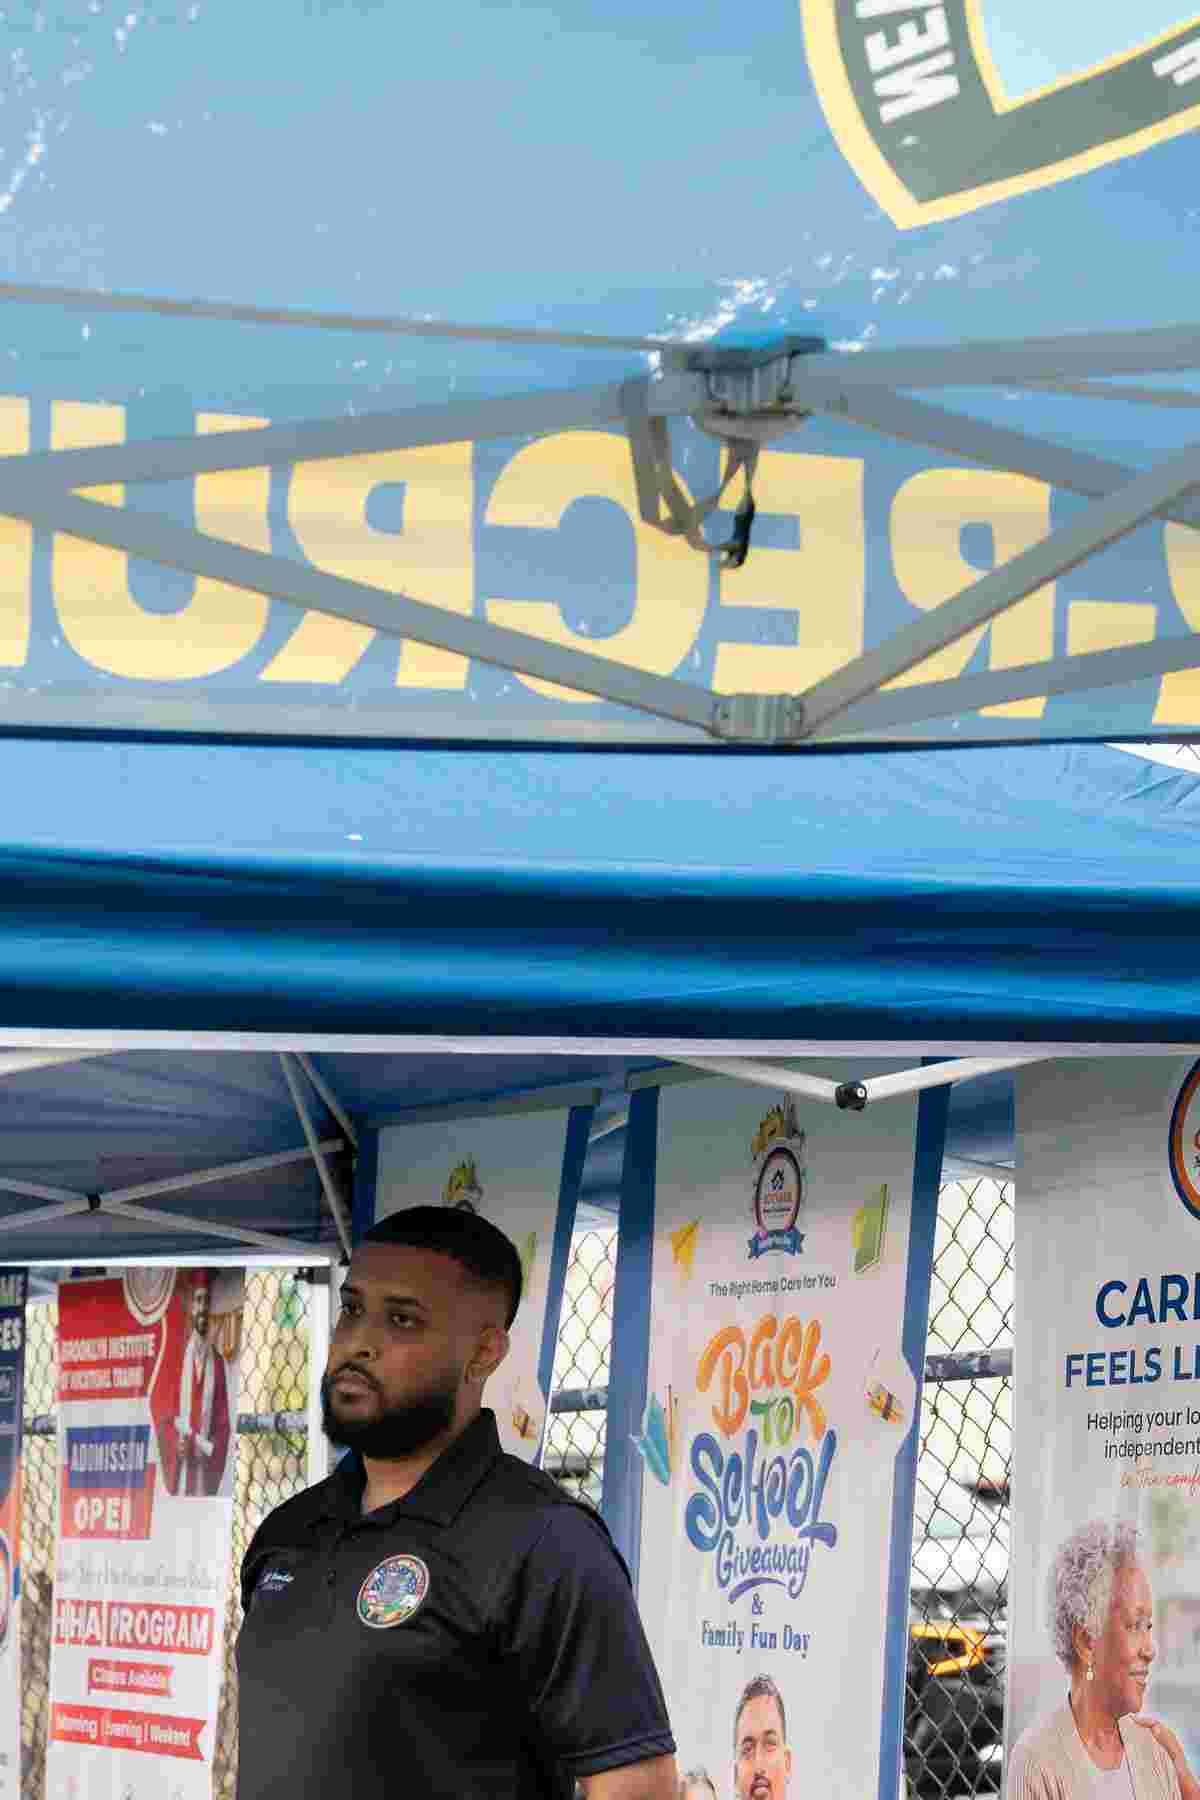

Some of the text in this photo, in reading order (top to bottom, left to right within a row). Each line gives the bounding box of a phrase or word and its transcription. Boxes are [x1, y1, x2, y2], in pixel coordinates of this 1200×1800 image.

[710, 1281, 728, 1297] The
[1065, 1347, 1162, 1388] FEELS
[1087, 1409, 1143, 1436] Helping
[1146, 1411, 1183, 1433] your
[751, 1592, 765, 1616] &
[111, 1604, 210, 1649] PROGRAM
[702, 1619, 811, 1659] Family Fun Day
